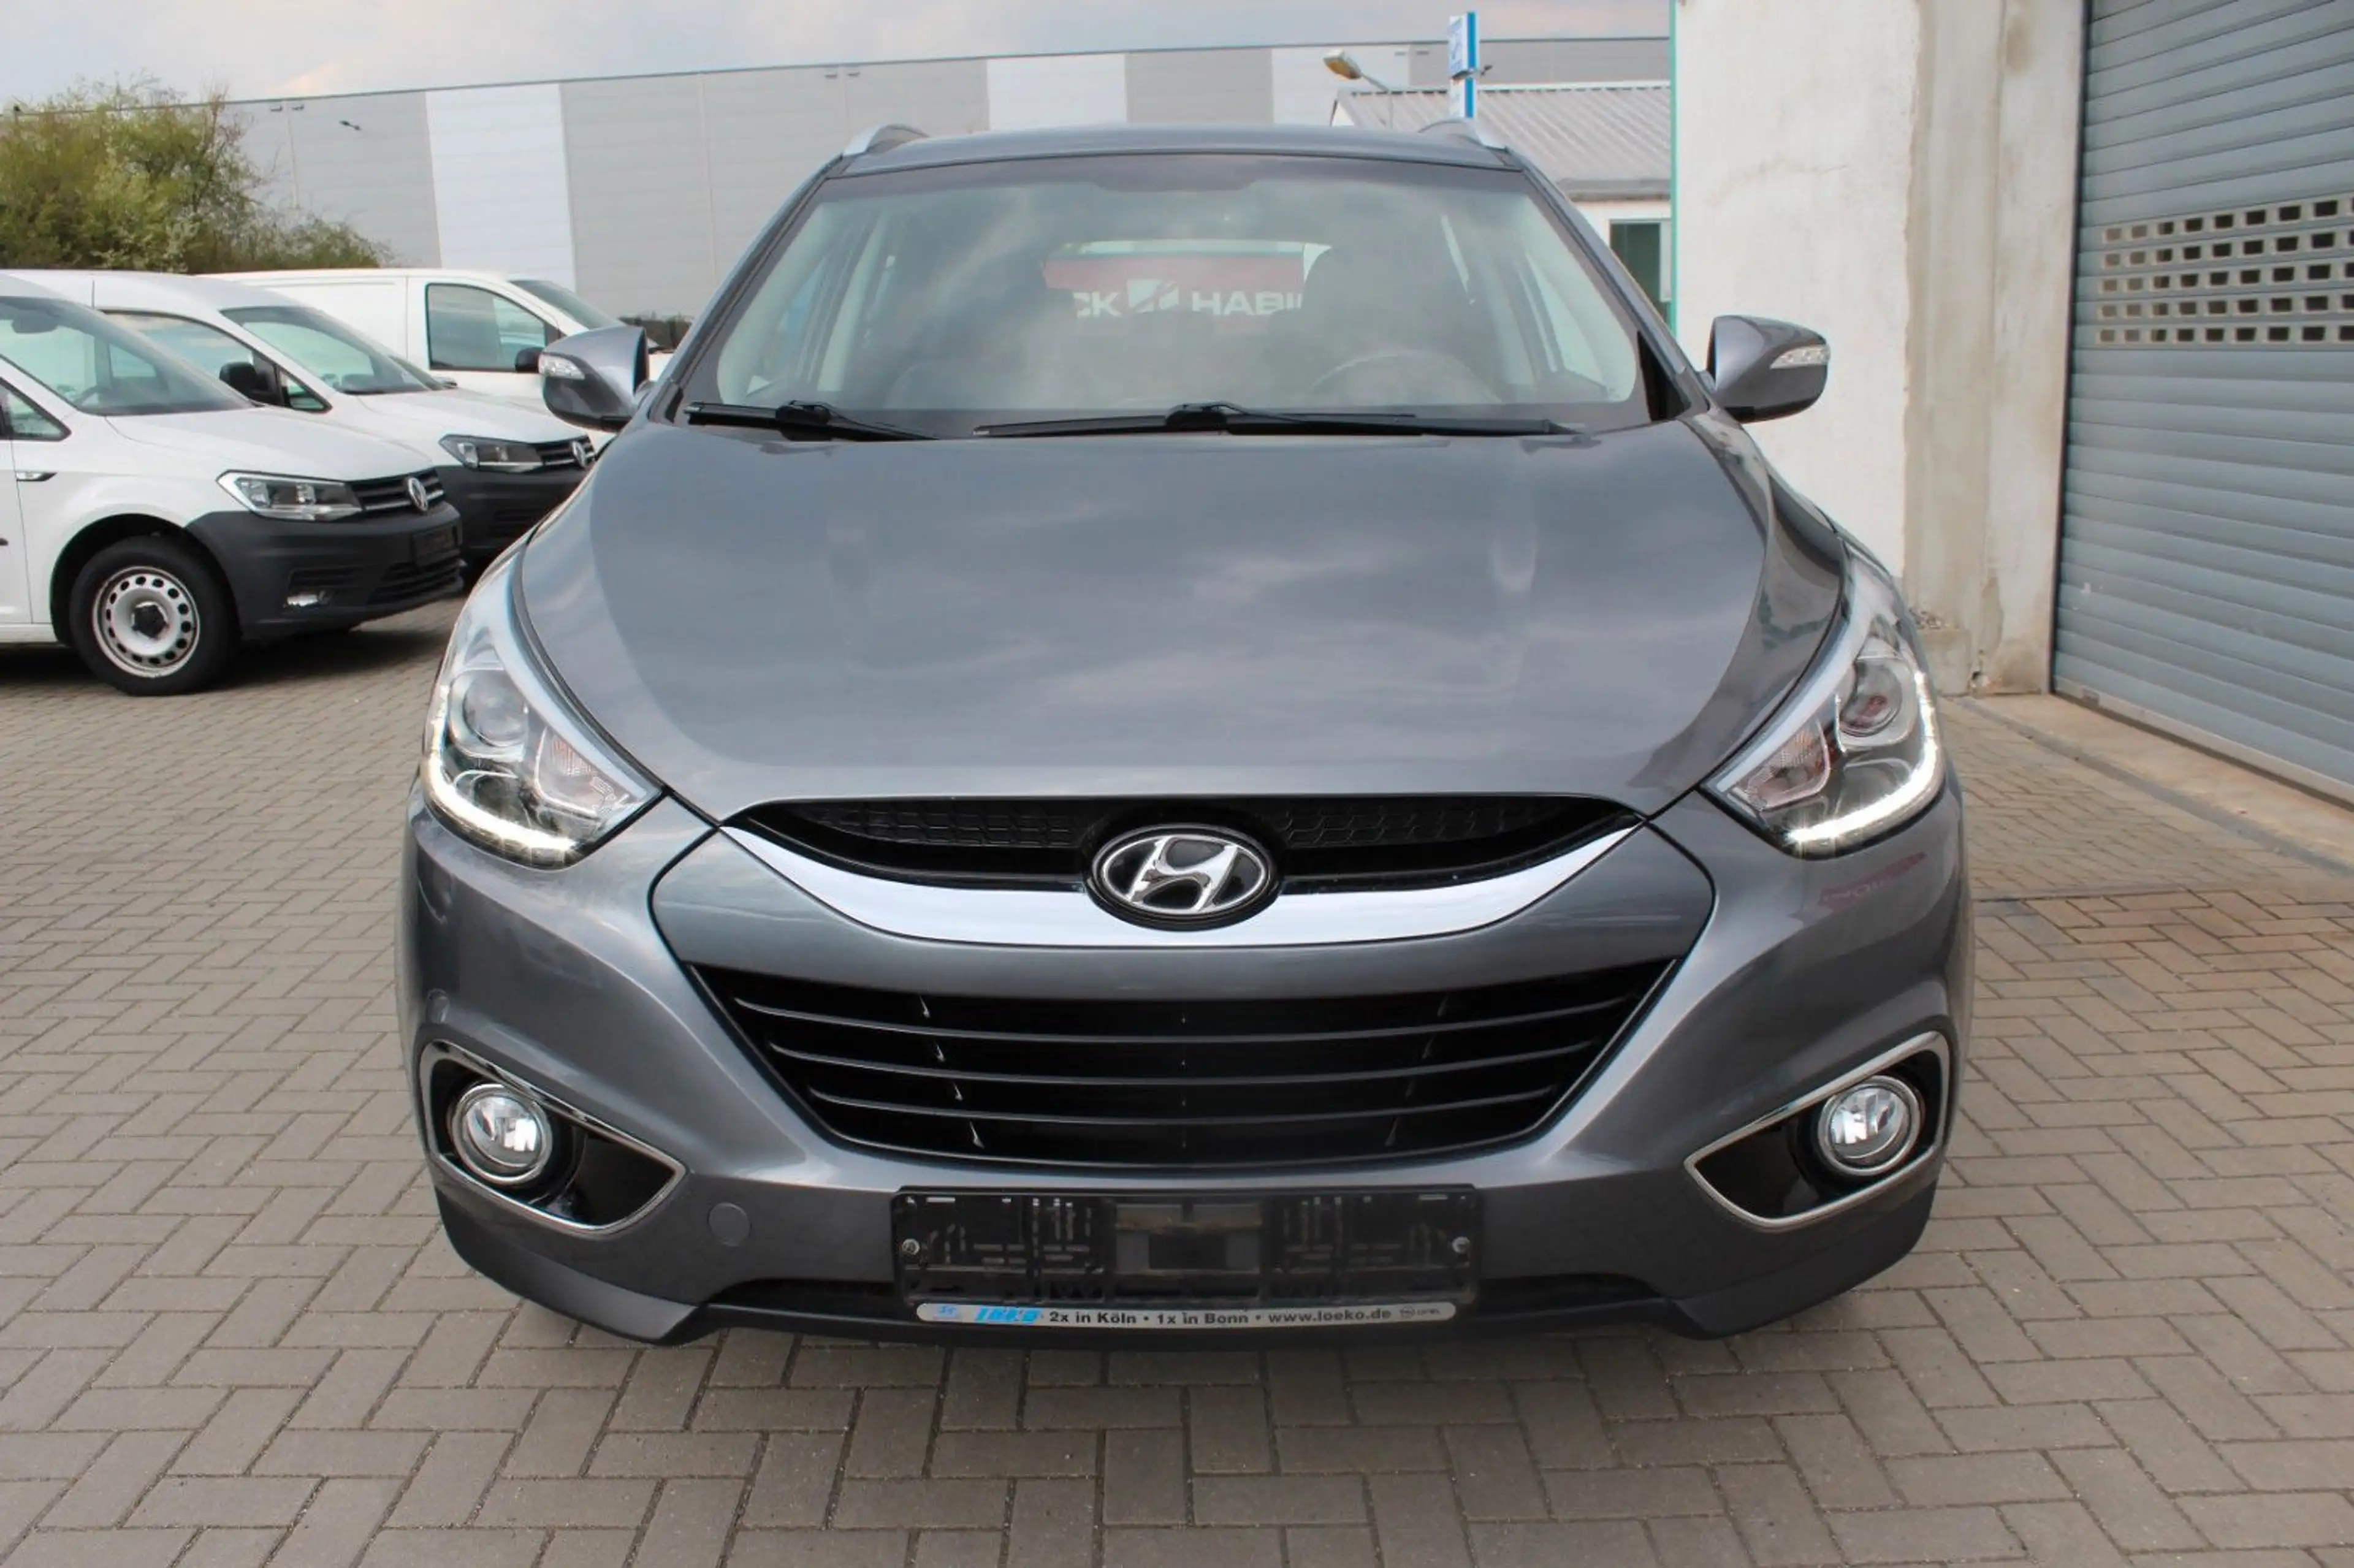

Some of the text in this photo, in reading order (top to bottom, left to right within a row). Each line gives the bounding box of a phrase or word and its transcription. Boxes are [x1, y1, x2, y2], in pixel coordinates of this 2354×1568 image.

[1049, 1311, 1069, 1323] 2x
[1076, 1311, 1091, 1323] in
[1097, 1312, 1137, 1324] Köln
[1157, 1313, 1176, 1325] 1x
[1182, 1312, 1198, 1325] in
[1205, 1313, 1249, 1325] Bonn
[1268, 1307, 1392, 1323] www.loeko.de
